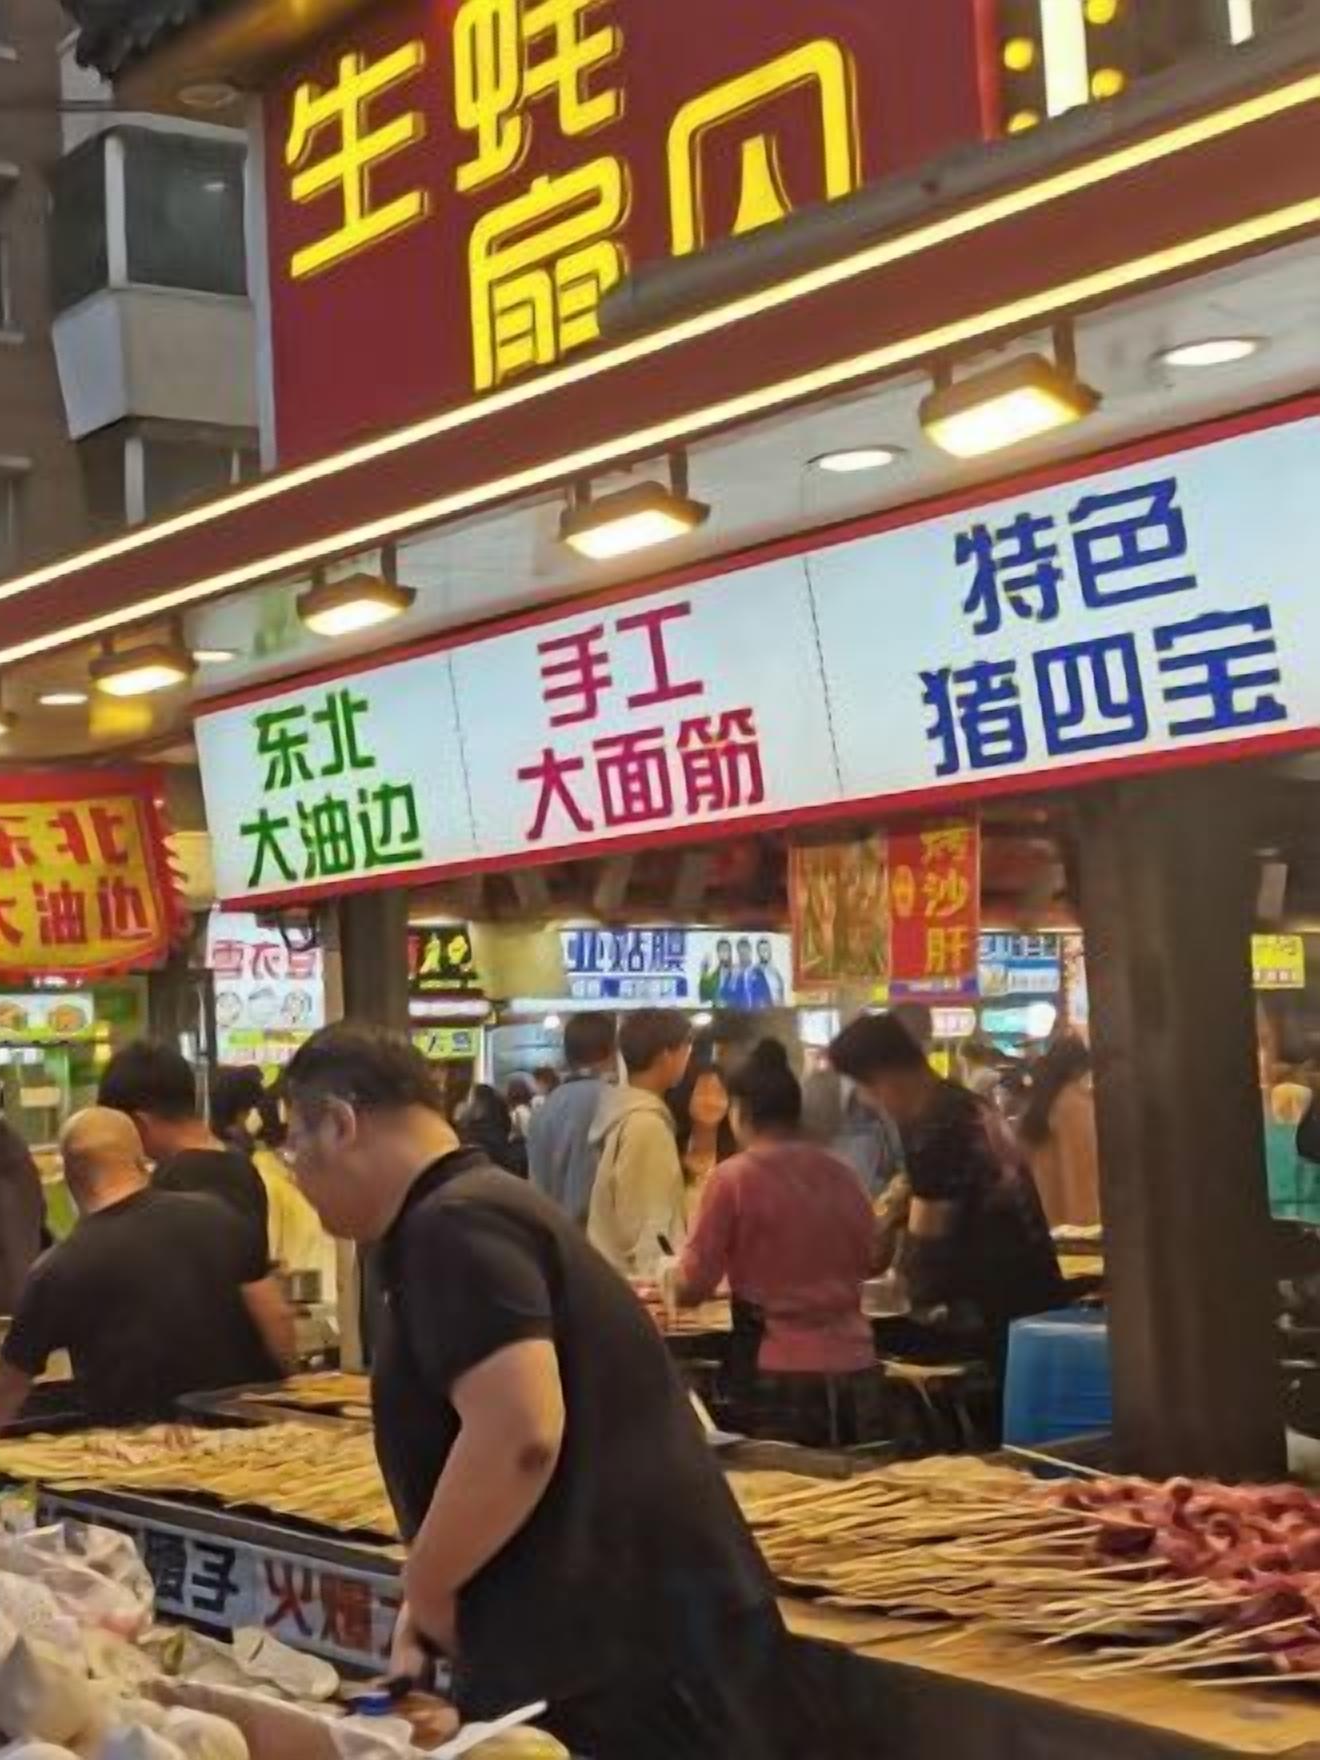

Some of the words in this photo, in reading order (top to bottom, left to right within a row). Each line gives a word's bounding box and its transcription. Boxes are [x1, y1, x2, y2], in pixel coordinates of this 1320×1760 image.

[286, 0, 624, 280] 生蚝
[954, 476, 1197, 636] 特色
[537, 600, 704, 728] 手工
[917, 603, 1289, 778] 猪四宝
[255, 687, 376, 792] 东北
[517, 707, 765, 840] 大面筋
[240, 782, 423, 888] 大油边
